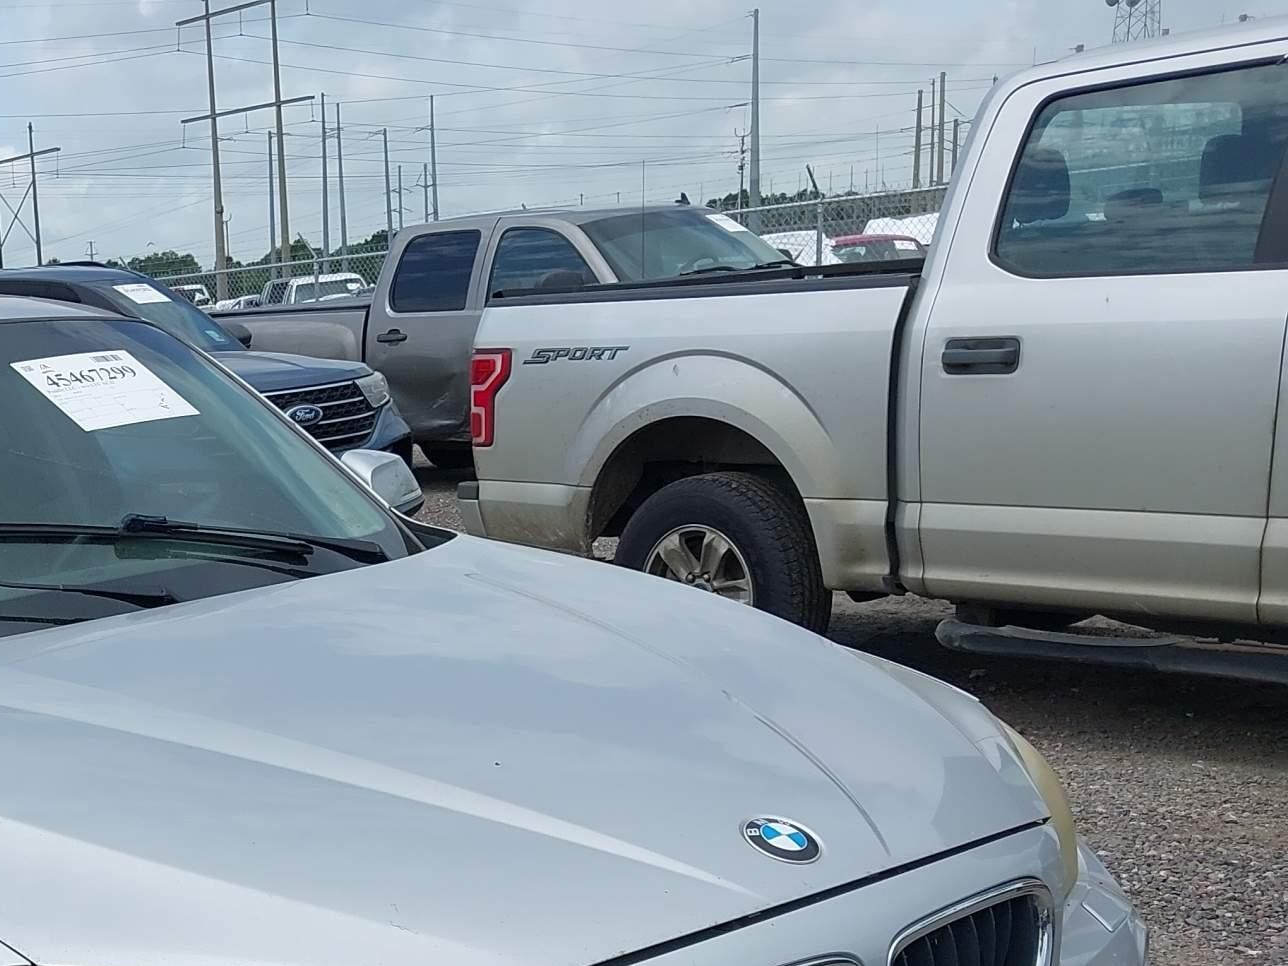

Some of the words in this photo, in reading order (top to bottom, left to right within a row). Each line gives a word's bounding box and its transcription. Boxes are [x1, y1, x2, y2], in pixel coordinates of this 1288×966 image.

[522, 346, 630, 365] SPORT
[46, 365, 137, 388] 45467299
[295, 409, 315, 421] Ford
